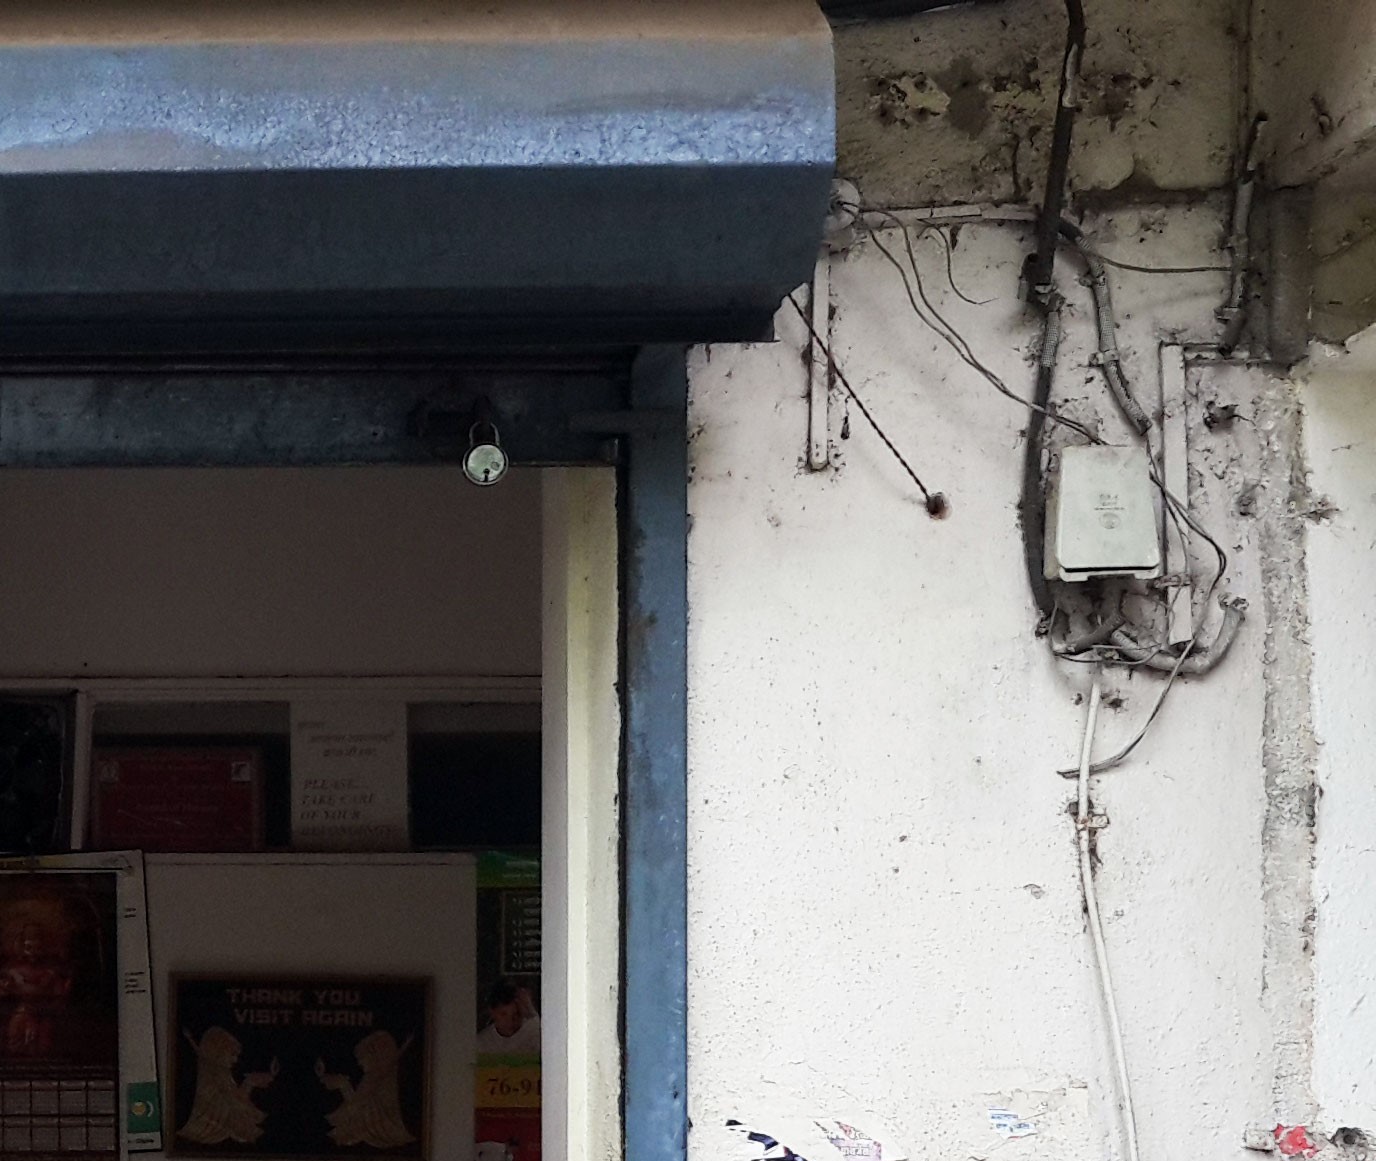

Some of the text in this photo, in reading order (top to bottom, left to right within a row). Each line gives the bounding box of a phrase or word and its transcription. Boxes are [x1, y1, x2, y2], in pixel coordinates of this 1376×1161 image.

[314, 989, 360, 1006] YOU
[233, 1008, 374, 1027] VISIT AGAIN
